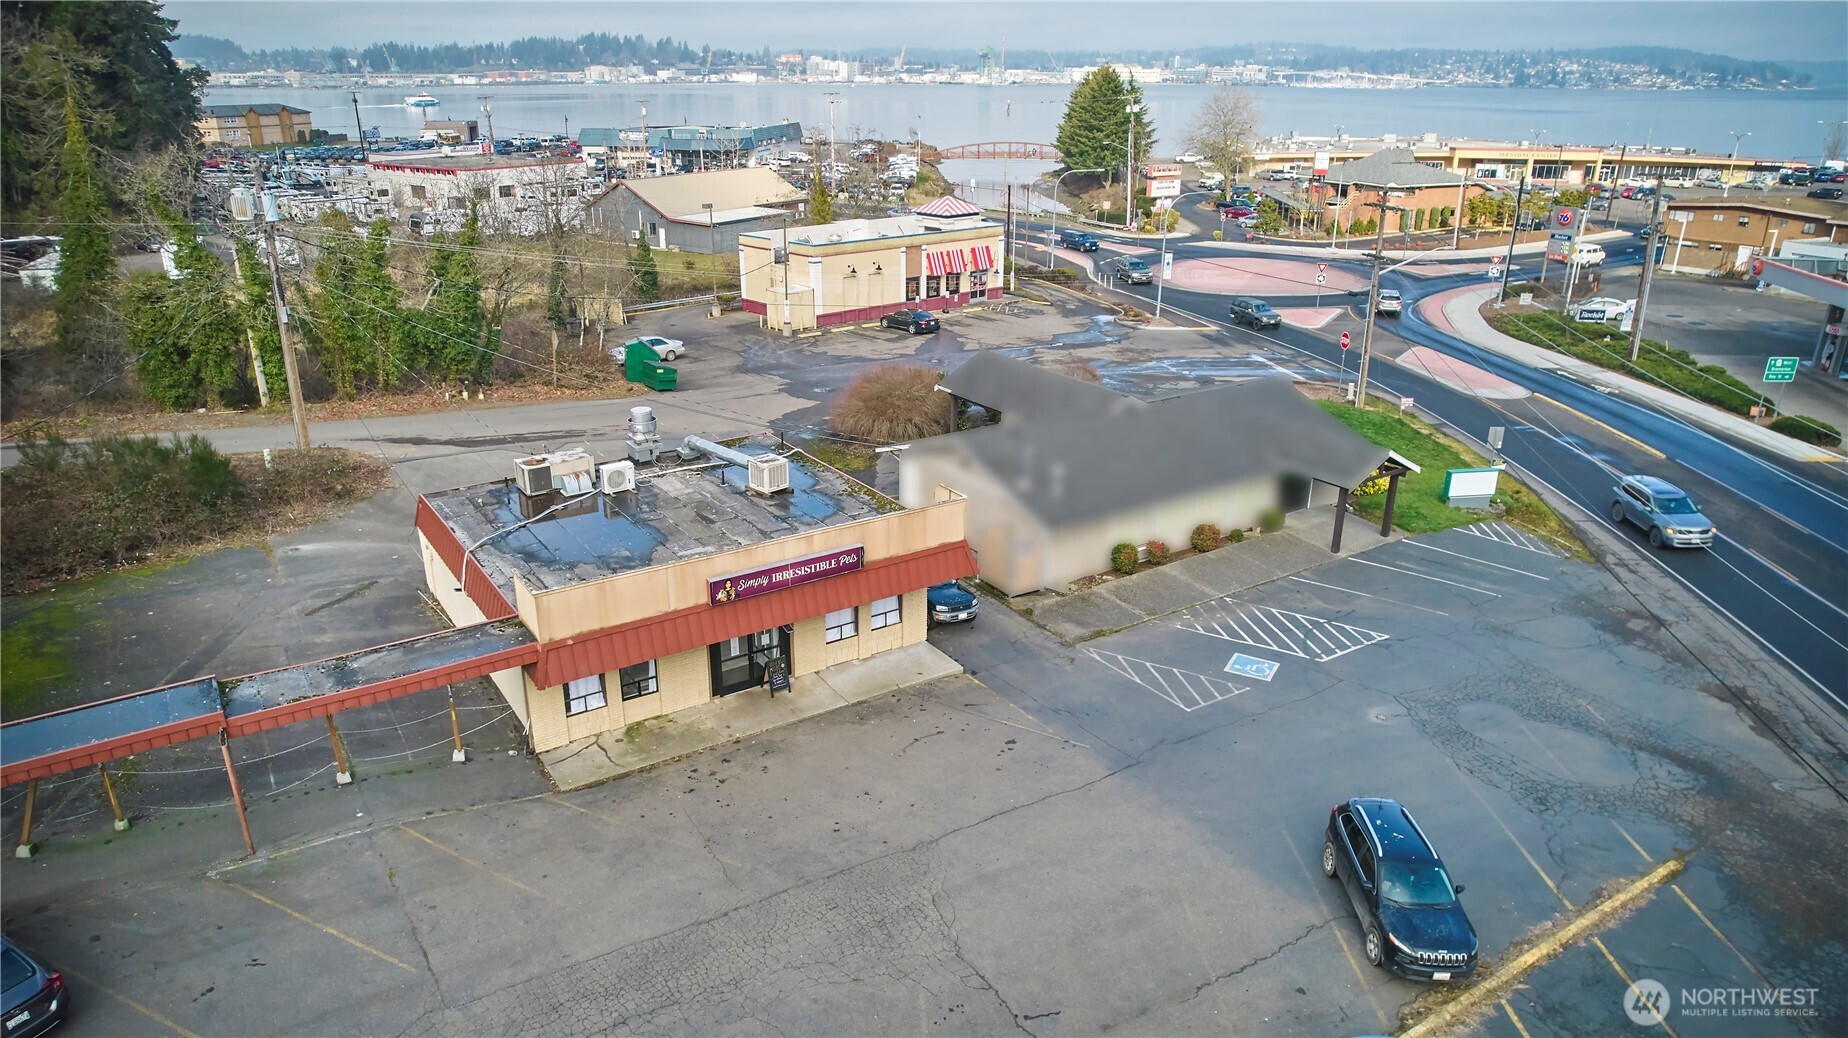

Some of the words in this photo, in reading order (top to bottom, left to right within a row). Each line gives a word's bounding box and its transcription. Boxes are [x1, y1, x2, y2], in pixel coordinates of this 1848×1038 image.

[1558, 213, 1571, 222] 76
[737, 575, 769, 591] Simply
[771, 559, 838, 583] IRRESISTIBLE
[839, 553, 858, 566] Pets
